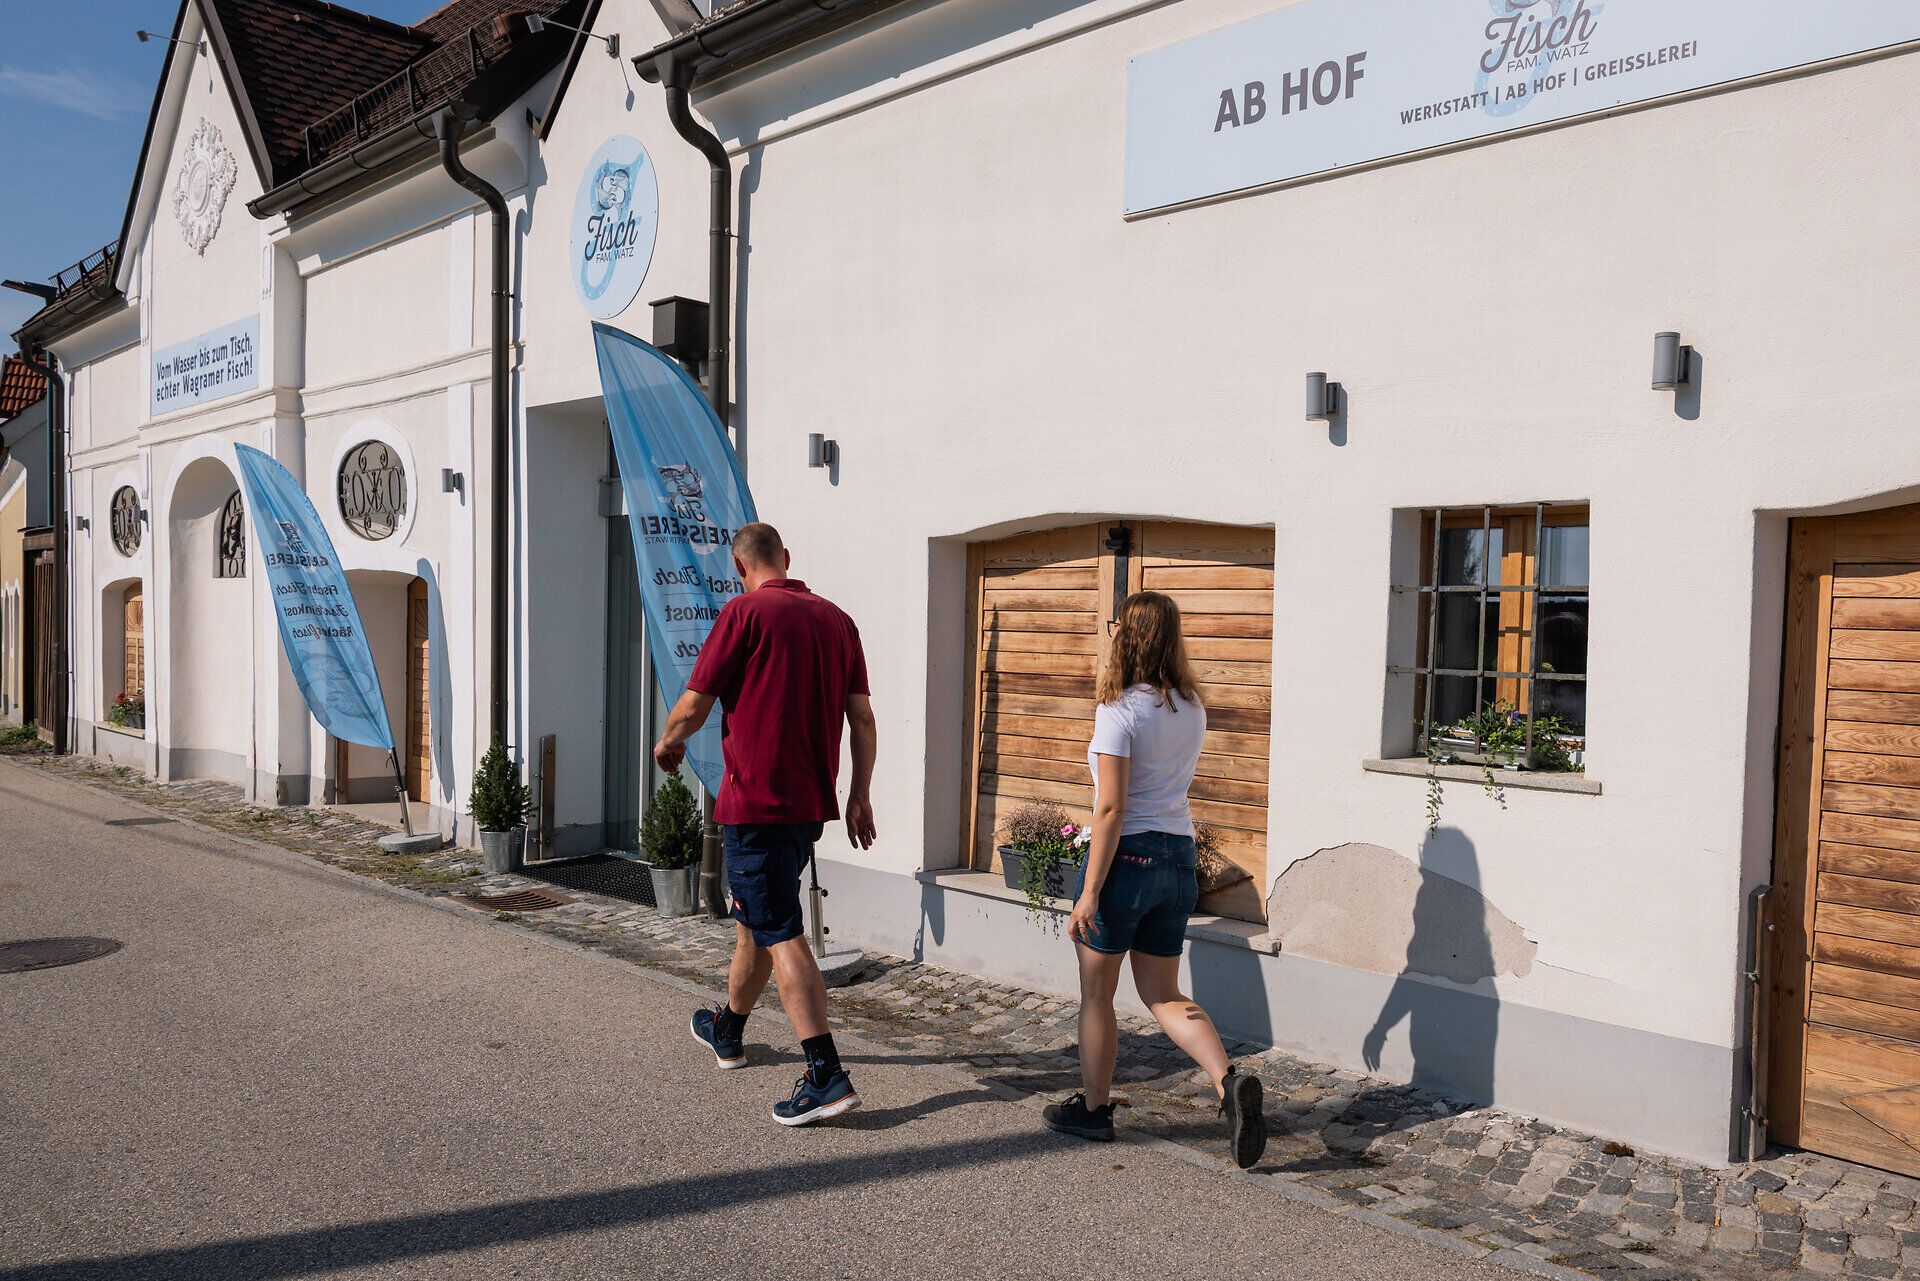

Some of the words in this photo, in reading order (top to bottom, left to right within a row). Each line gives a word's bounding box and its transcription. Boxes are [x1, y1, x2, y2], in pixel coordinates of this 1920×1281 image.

[1480, 0, 1597, 73] Fisch
[1507, 55, 1542, 74] FAM.
[1546, 42, 1589, 63] WATZ
[1214, 81, 1267, 132] AB
[1282, 51, 1367, 115] HOF
[1400, 91, 1488, 125] WERKSTATT
[1505, 82, 1527, 100] AB
[1533, 72, 1566, 94] HOF
[1584, 40, 1698, 81] GREISSLEREI
[584, 210, 638, 261] Fisch
[596, 252, 613, 264] FAM.
[614, 247, 634, 260] WATZ
[156, 361, 172, 381] Vom
[173, 354, 198, 376] Wasser
[199, 347, 210, 368] bis
[211, 344, 228, 364] zum
[229, 332, 253, 357] Tisch,
[156, 381, 180, 402] echter
[182, 368, 224, 397] Wagramer
[227, 354, 253, 382] Fisch!
